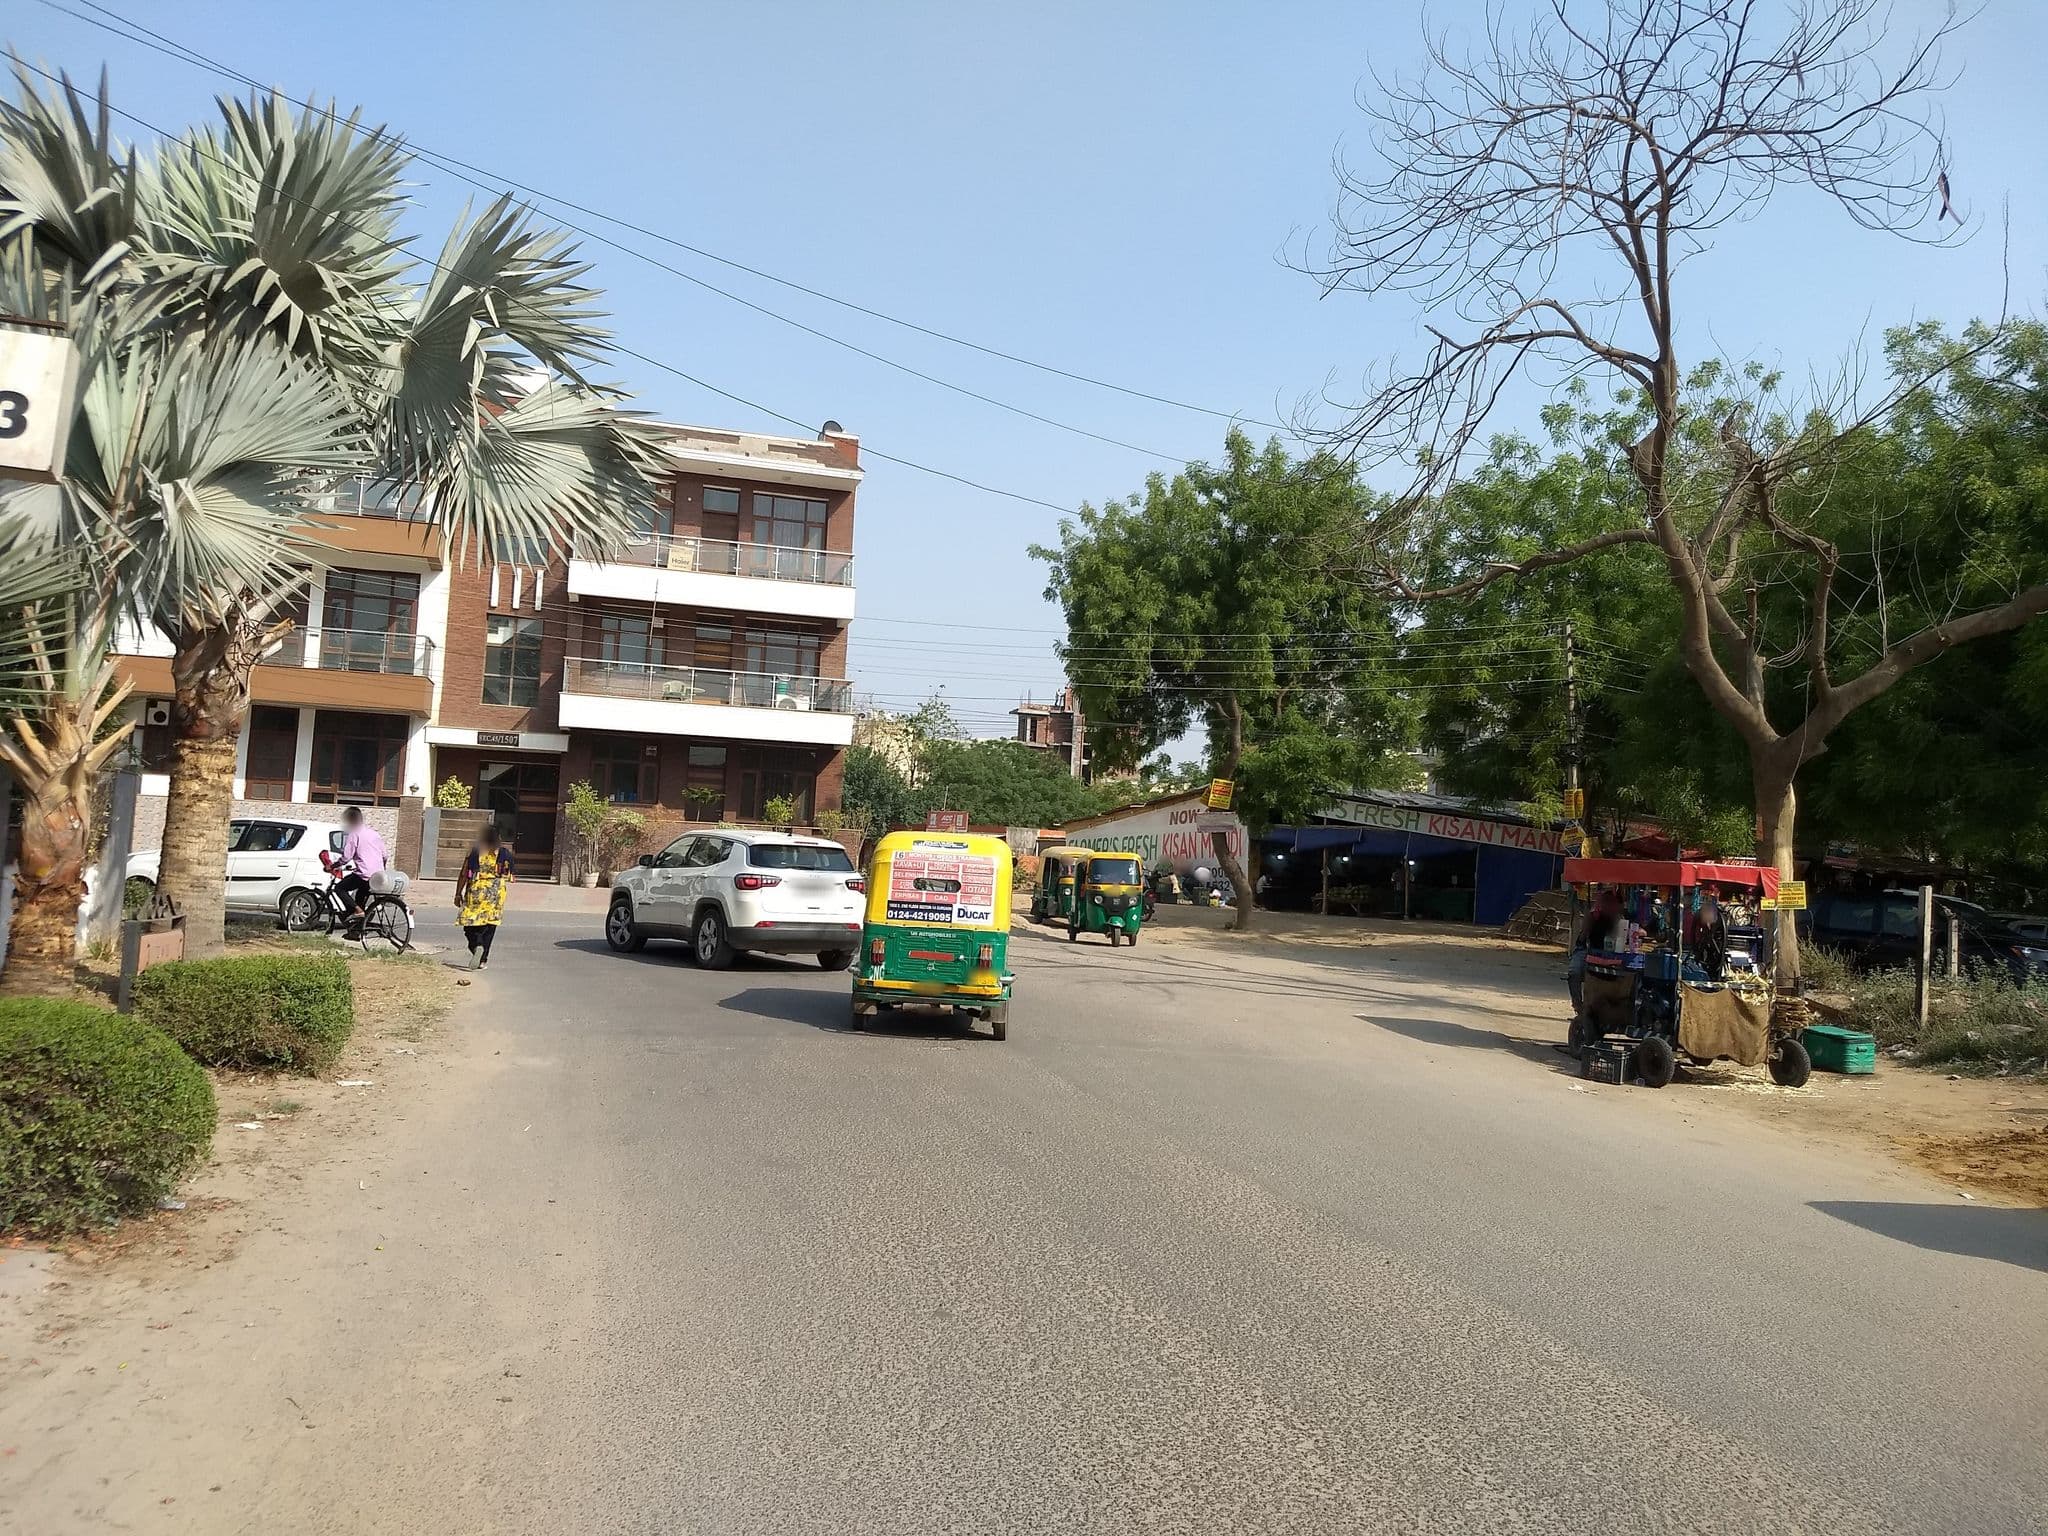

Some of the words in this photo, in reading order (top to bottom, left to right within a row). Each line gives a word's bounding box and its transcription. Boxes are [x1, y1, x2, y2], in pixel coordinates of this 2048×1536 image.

[0, 390, 29, 439] 3
[1354, 804, 1420, 830] FRESH
[1428, 815, 1495, 842] KISAN
[1122, 833, 1158, 861] FRESH
[1162, 832, 1197, 859] KISAN
[1201, 828, 1242, 859] MDI
[887, 910, 951, 921] 0124-4219095
[957, 908, 990, 920] DUCAT
